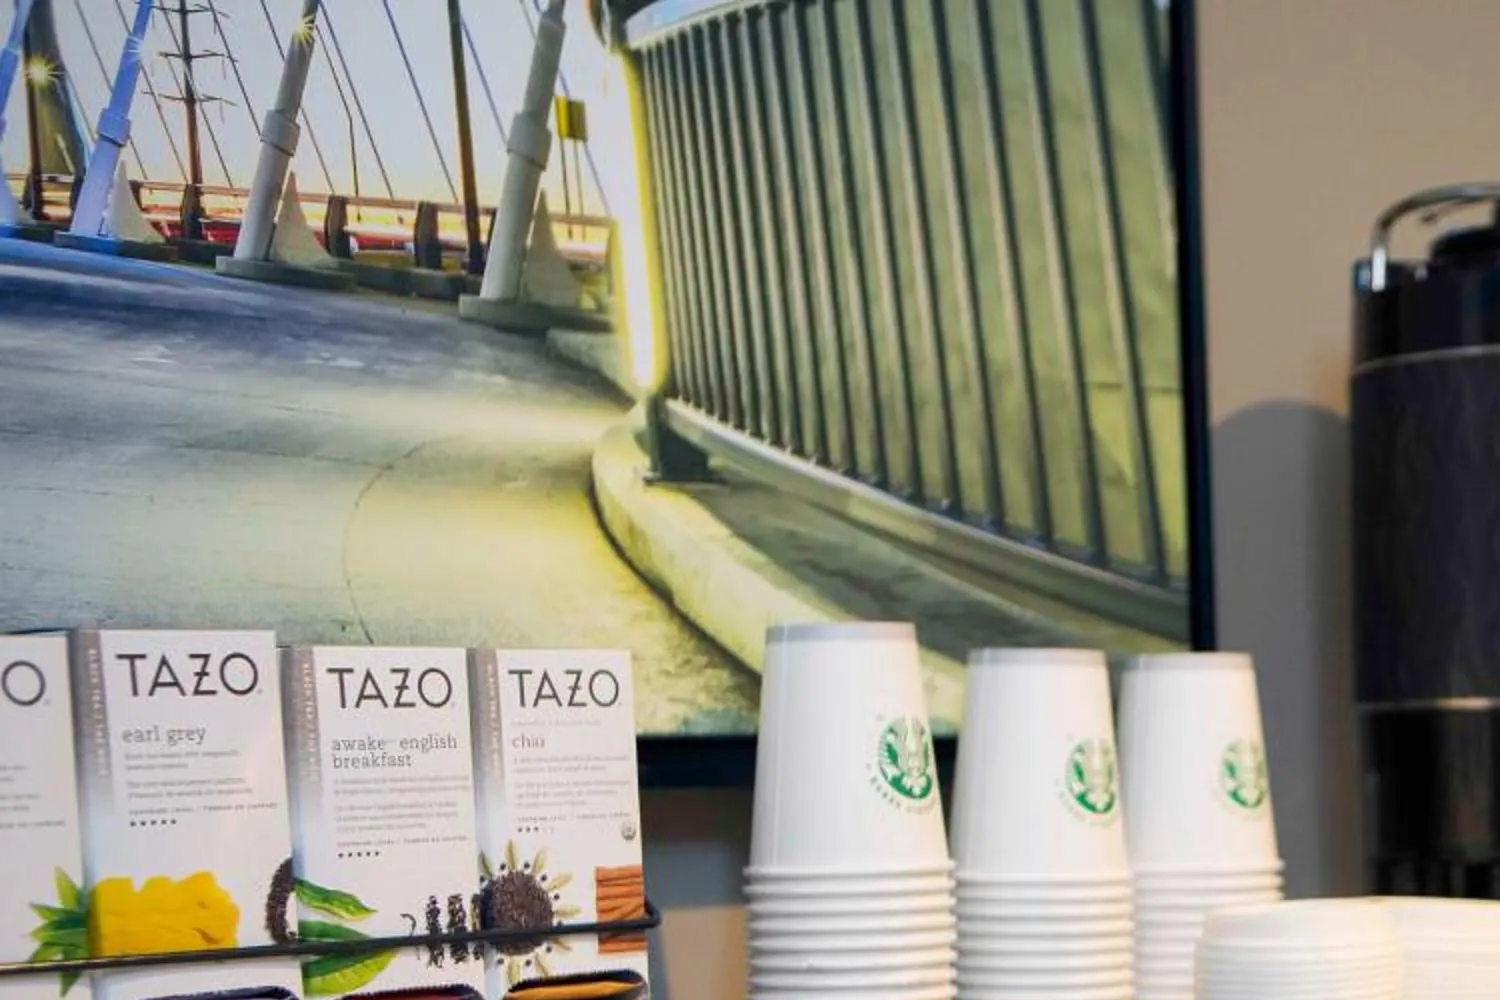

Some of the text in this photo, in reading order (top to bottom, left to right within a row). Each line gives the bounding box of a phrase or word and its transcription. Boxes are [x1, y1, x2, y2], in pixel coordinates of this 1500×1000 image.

[122, 725, 208, 747] earl grey
[331, 732, 458, 753] awake english
[511, 733, 546, 750] chai
[332, 752, 413, 769] breakfast
